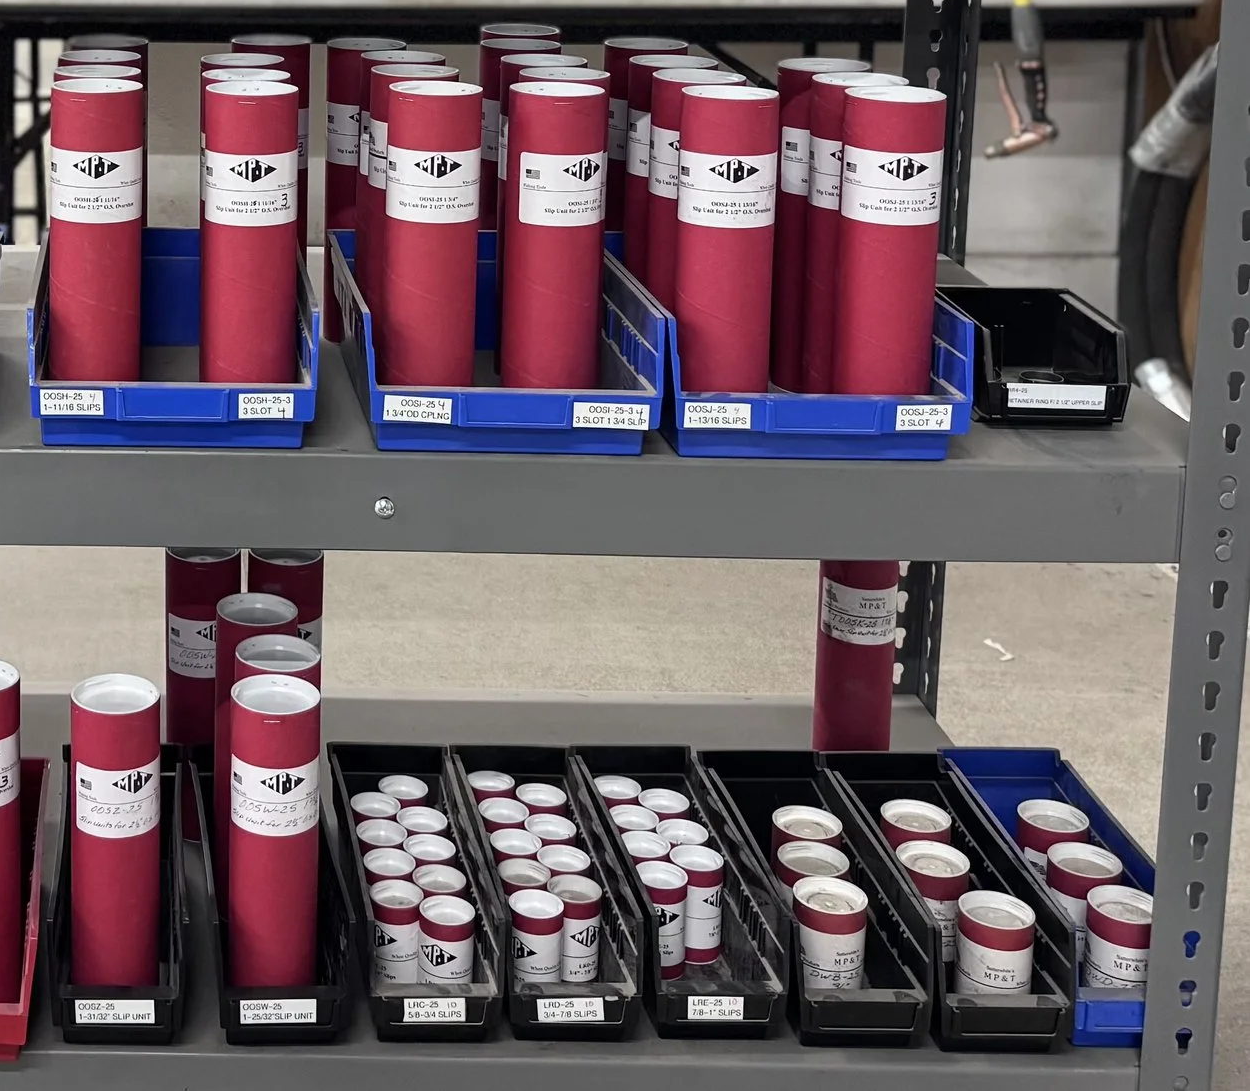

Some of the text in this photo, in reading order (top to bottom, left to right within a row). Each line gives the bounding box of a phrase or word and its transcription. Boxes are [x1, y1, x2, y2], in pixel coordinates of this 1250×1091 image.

[281, 194, 288, 207] 3
[929, 192, 937, 205] 3
[43, 392, 83, 401] OOSH-25
[243, 396, 291, 405] OOSH-25-3
[44, 403, 101, 412] 1-11/16 SLIPS
[400, 399, 436, 409] OOSI-25
[250, 407, 272, 415] SLOT
[277, 407, 286, 418] 4
[588, 405, 634, 415] OOSI-25-3
[687, 405, 727, 414] OOSJ-25
[900, 407, 948, 417] OOSJ-25-3
[421, 411, 450, 420] CPLNG
[582, 416, 605, 425] SLOT
[612, 417, 627, 426] 3/4
[629, 417, 647, 426] SLIP
[688, 416, 747, 425] 1-13/16 SLIPS
[907, 418, 930, 427] SLOT
[935, 419, 944, 428] 4
[0, 775, 9, 789] 3
[78, 1003, 115, 1011] OOSZ-25
[242, 1003, 282, 1011] OOSW-25
[407, 1001, 439, 1009] LRC-25
[543, 1001, 575, 1009] LRD-25
[692, 999, 723, 1007] LRE-25
[112, 1012, 131, 1021] SLIP
[132, 1012, 151, 1020] UNIT
[294, 1012, 313, 1020] UNIT
[408, 1010, 462, 1019] 5/8-3/4 SLIPS
[543, 1010, 598, 1019] 3/4-7/8 SLIPS
[718, 1008, 742, 1017] SLIPS
